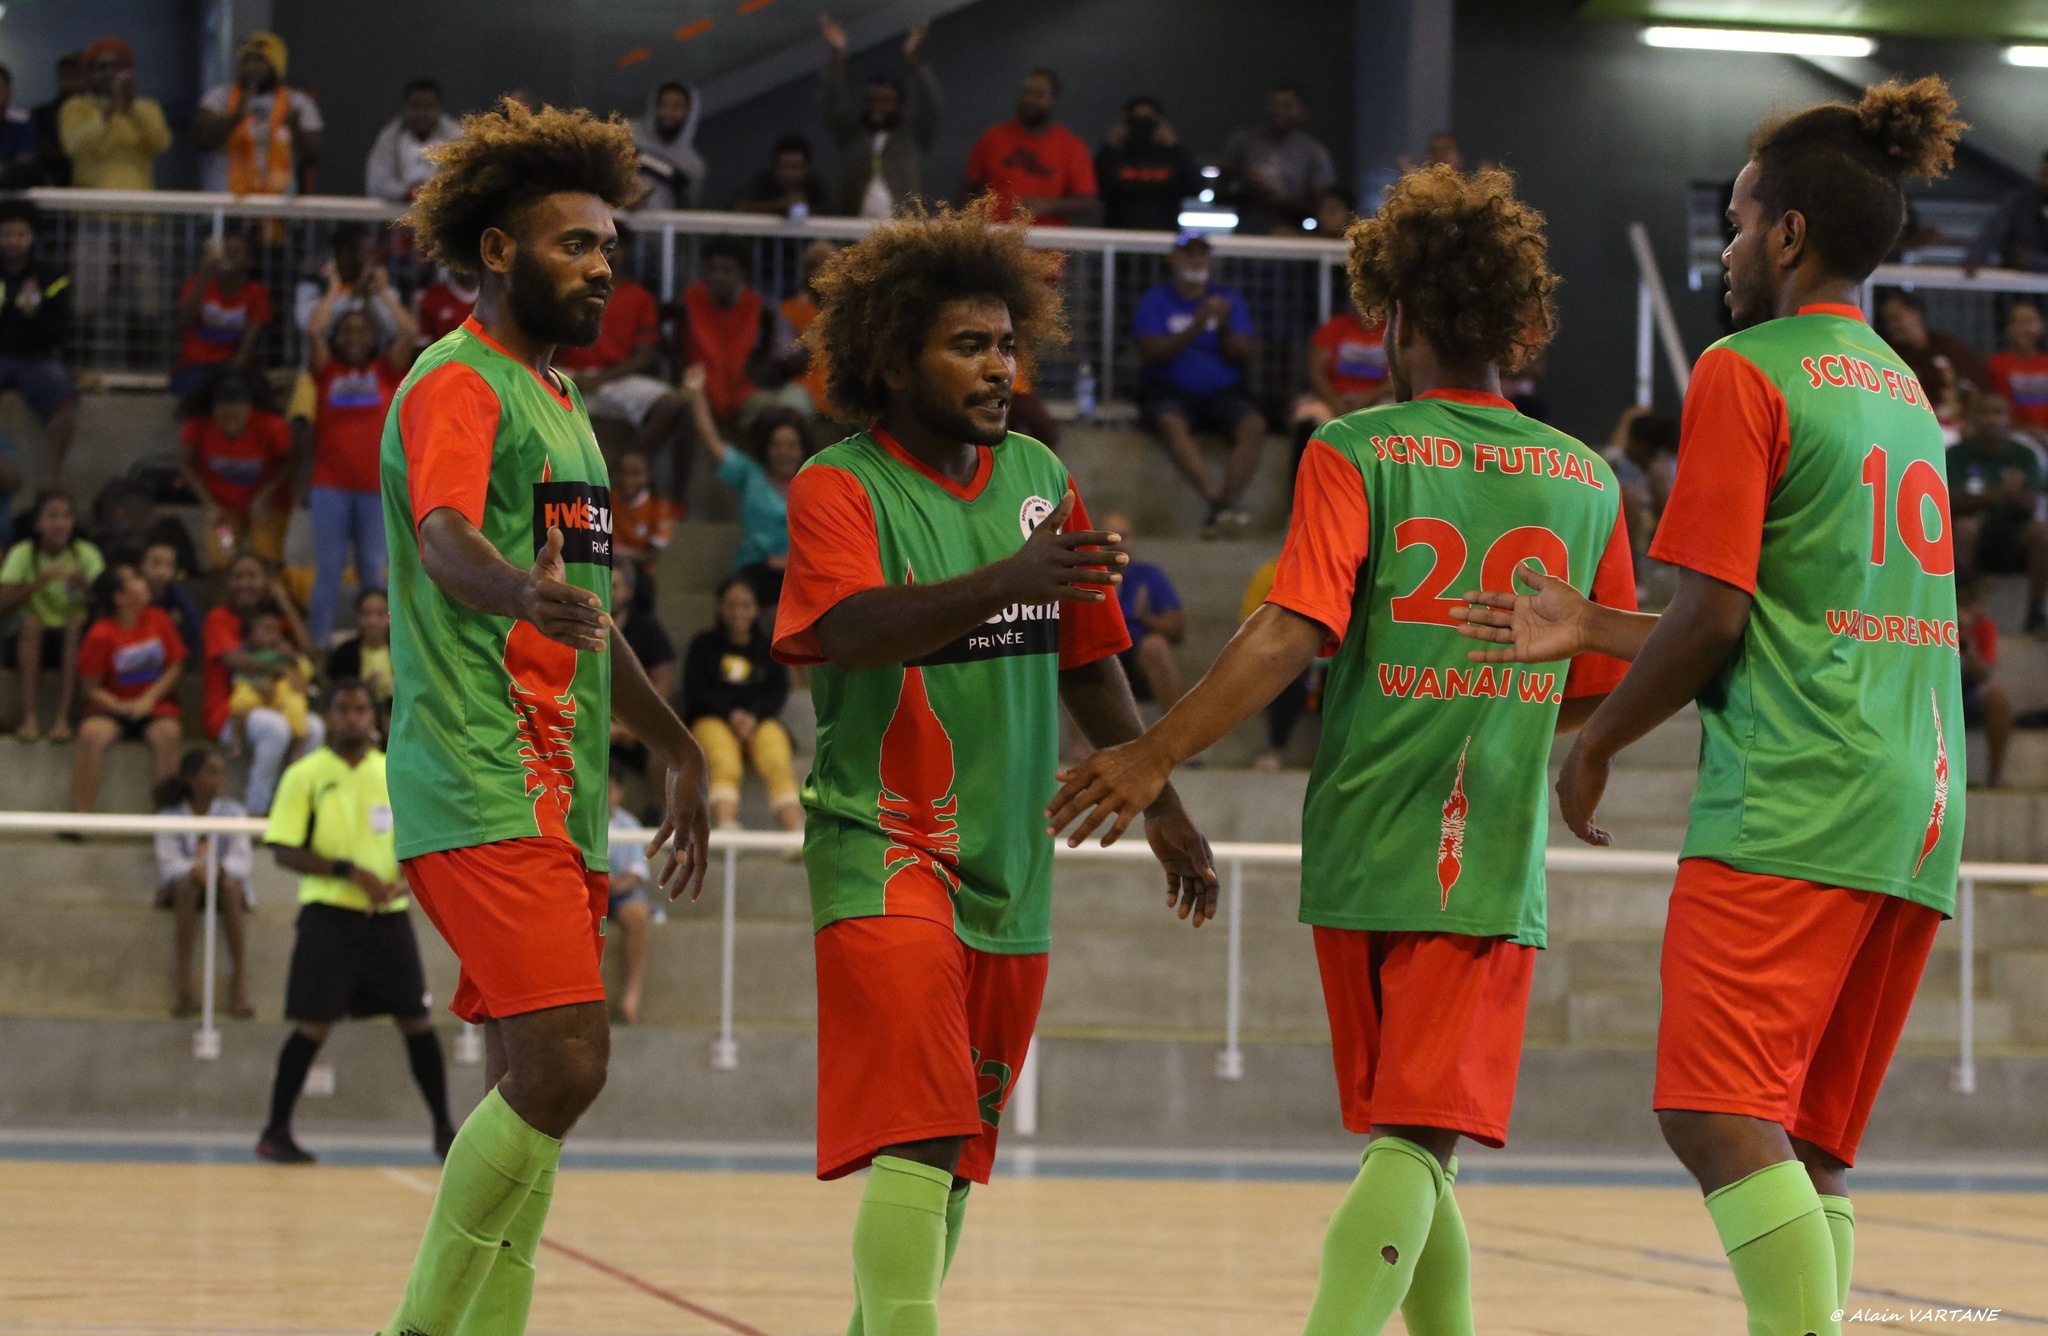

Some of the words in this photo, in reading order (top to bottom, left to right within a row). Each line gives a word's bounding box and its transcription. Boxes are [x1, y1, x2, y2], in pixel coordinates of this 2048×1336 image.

[1801, 354, 1881, 393] SCND
[1882, 368, 1934, 413] FUT
[1370, 435, 1462, 468] SCND
[1473, 442, 1604, 491] FUTSAL
[1862, 443, 1954, 576] 10
[969, 628, 1025, 650] PRIVÉE
[1378, 663, 1513, 700] WANAI
[1518, 670, 1562, 704] W.
[970, 1045, 1012, 1129] 2
